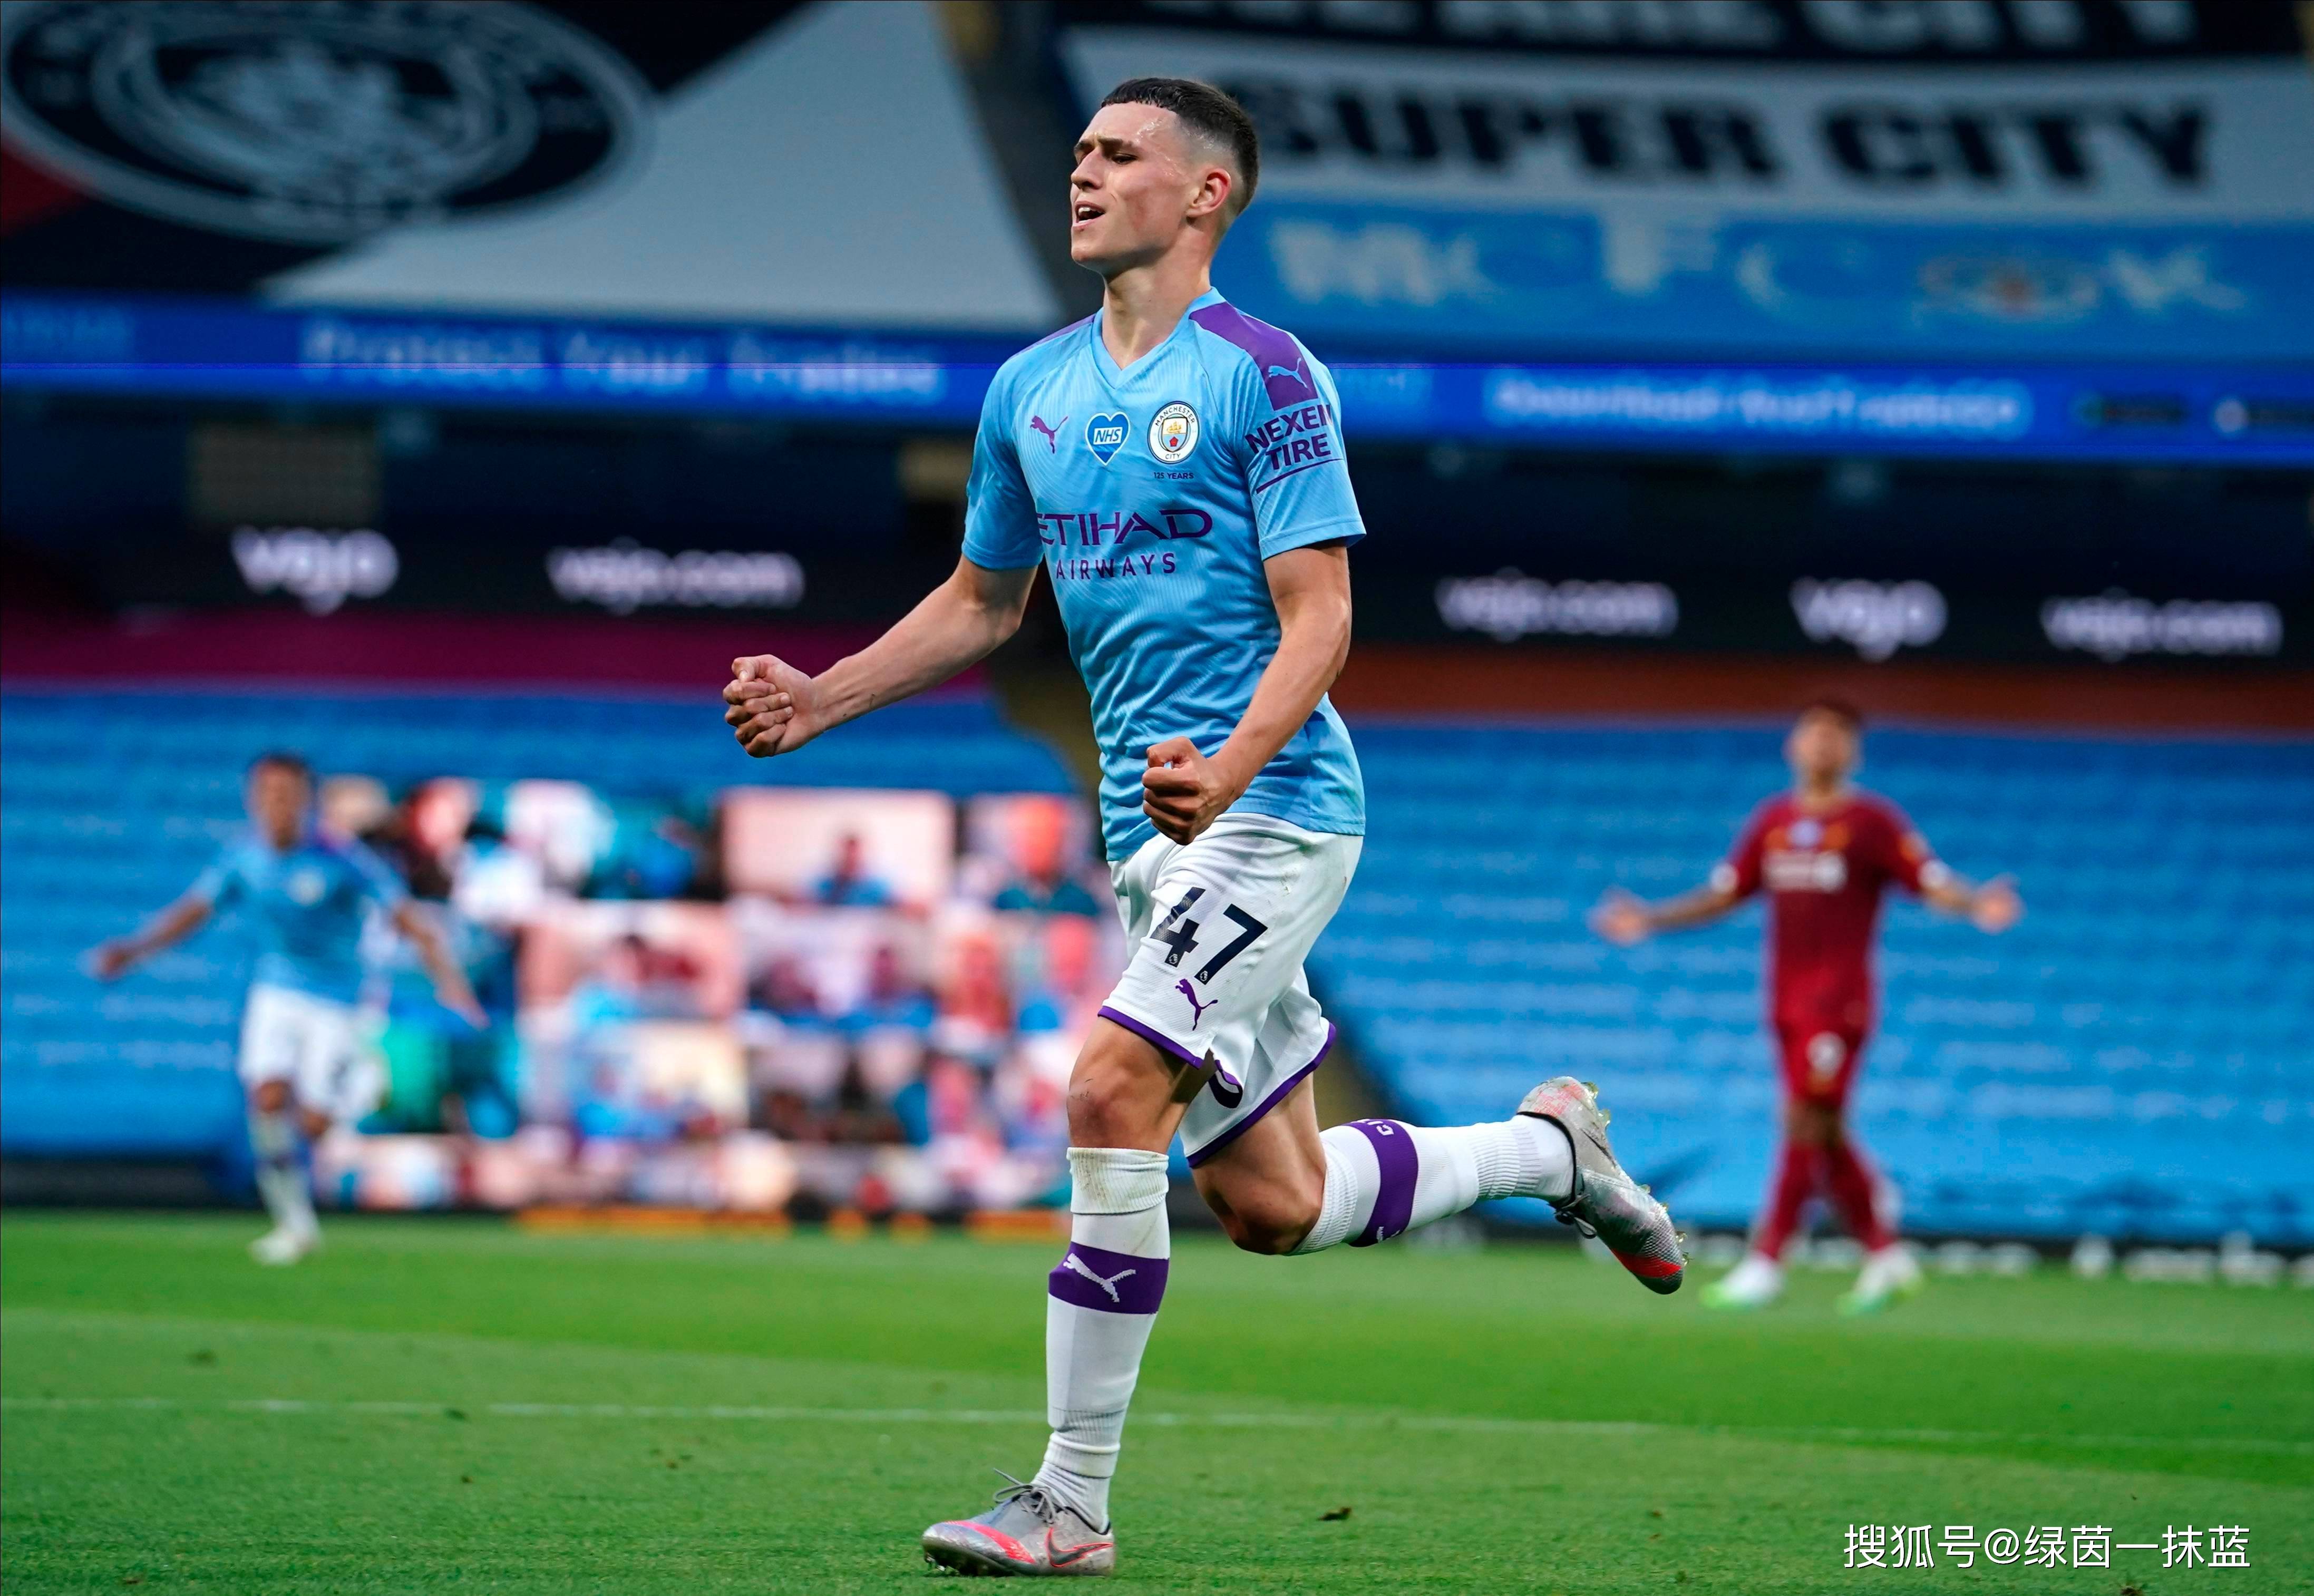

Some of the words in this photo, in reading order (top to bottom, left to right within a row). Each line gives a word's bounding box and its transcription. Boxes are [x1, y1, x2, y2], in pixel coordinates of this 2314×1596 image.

[1226, 79, 1784, 184] SUPER
[1816, 100, 2209, 190] CITY
[1155, 405, 1195, 426] MANCHESTER
[1095, 429, 1121, 443] NHS
[1265, 433, 1331, 470] TIRE
[1036, 509, 1213, 546] ETIHAD
[1056, 552, 1176, 580] AIRWAYS
[1150, 887, 1268, 985] 47
